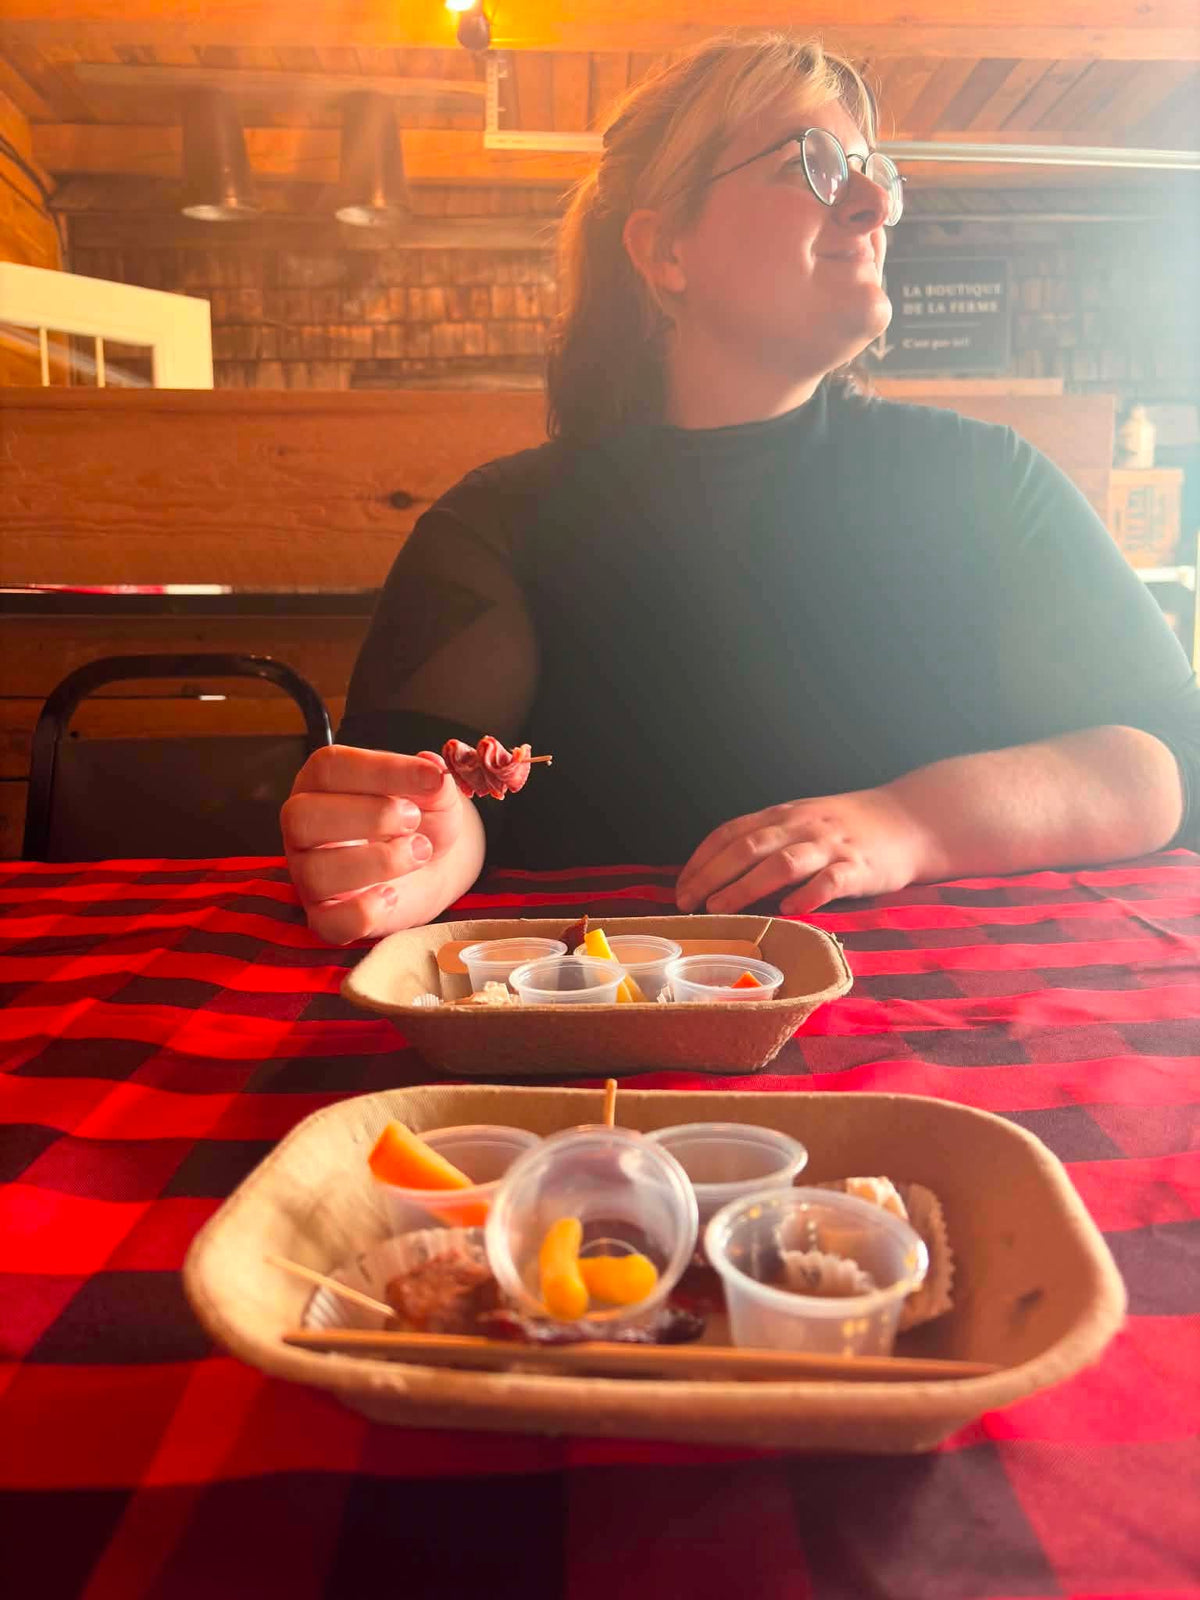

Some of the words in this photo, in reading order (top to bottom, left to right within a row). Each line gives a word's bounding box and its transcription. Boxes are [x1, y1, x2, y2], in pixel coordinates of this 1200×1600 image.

[903, 285, 922, 297] LA
[925, 283, 1001, 297] BOUTIQUE
[903, 303, 922, 315] DE
[927, 302, 946, 313] LA
[950, 301, 998, 313] FERME
